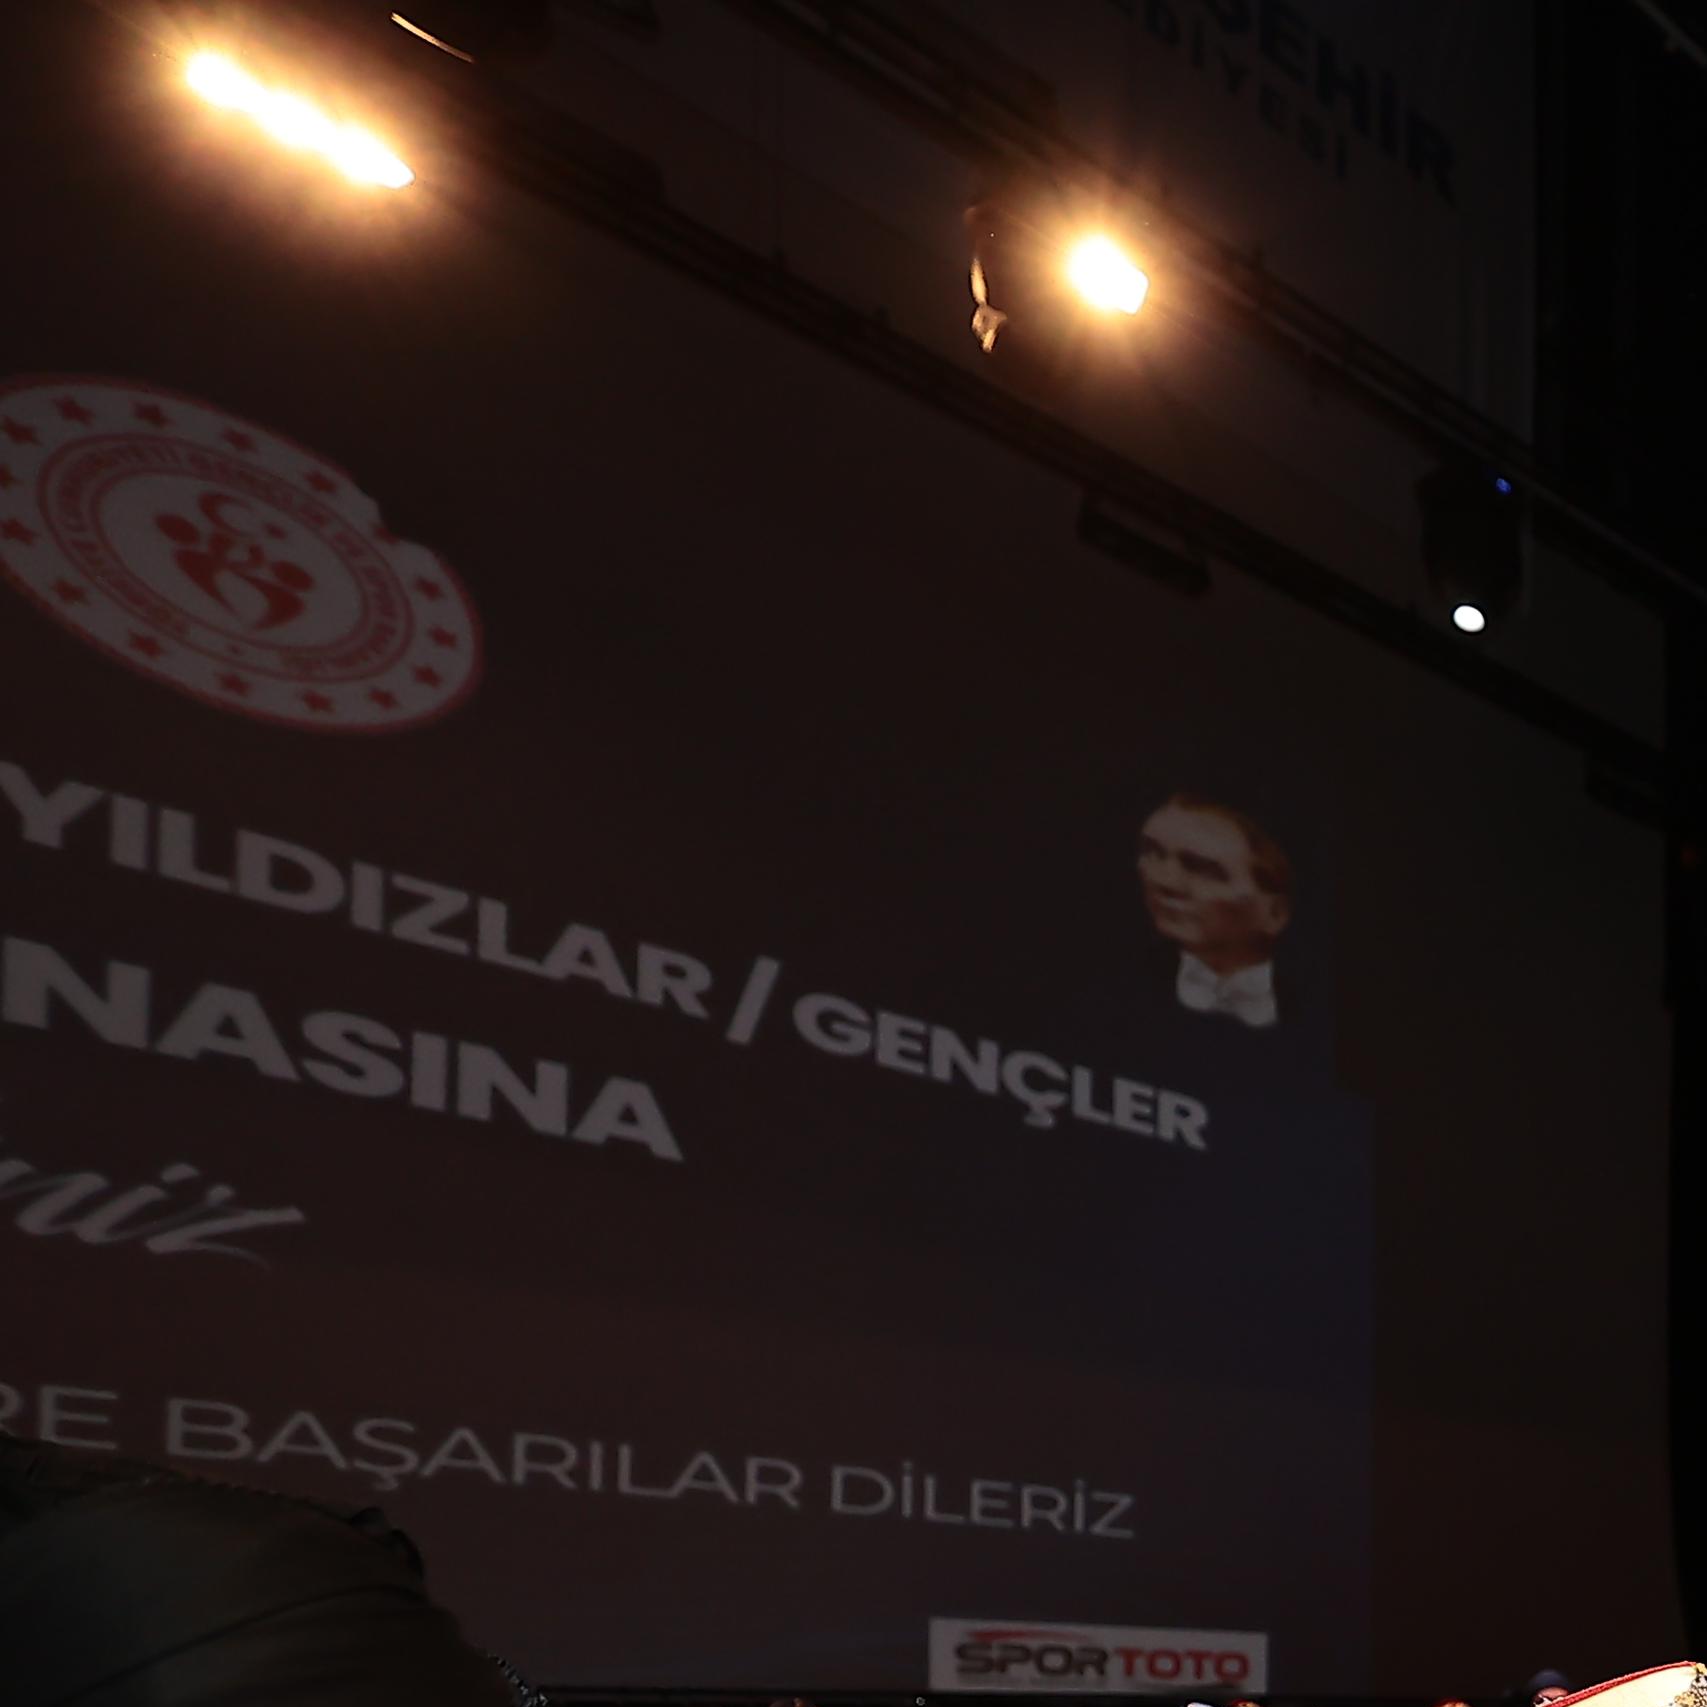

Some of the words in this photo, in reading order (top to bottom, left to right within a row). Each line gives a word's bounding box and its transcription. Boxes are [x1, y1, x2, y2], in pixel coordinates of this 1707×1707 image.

[0, 761, 713, 1019] YILDIZLAR
[792, 993, 1209, 1151] GENÇLER
[3, 935, 685, 1163] NASINA
[165, 1397, 804, 1508] BAŞARILAR
[830, 1459, 1136, 1539] DİLERİZ
